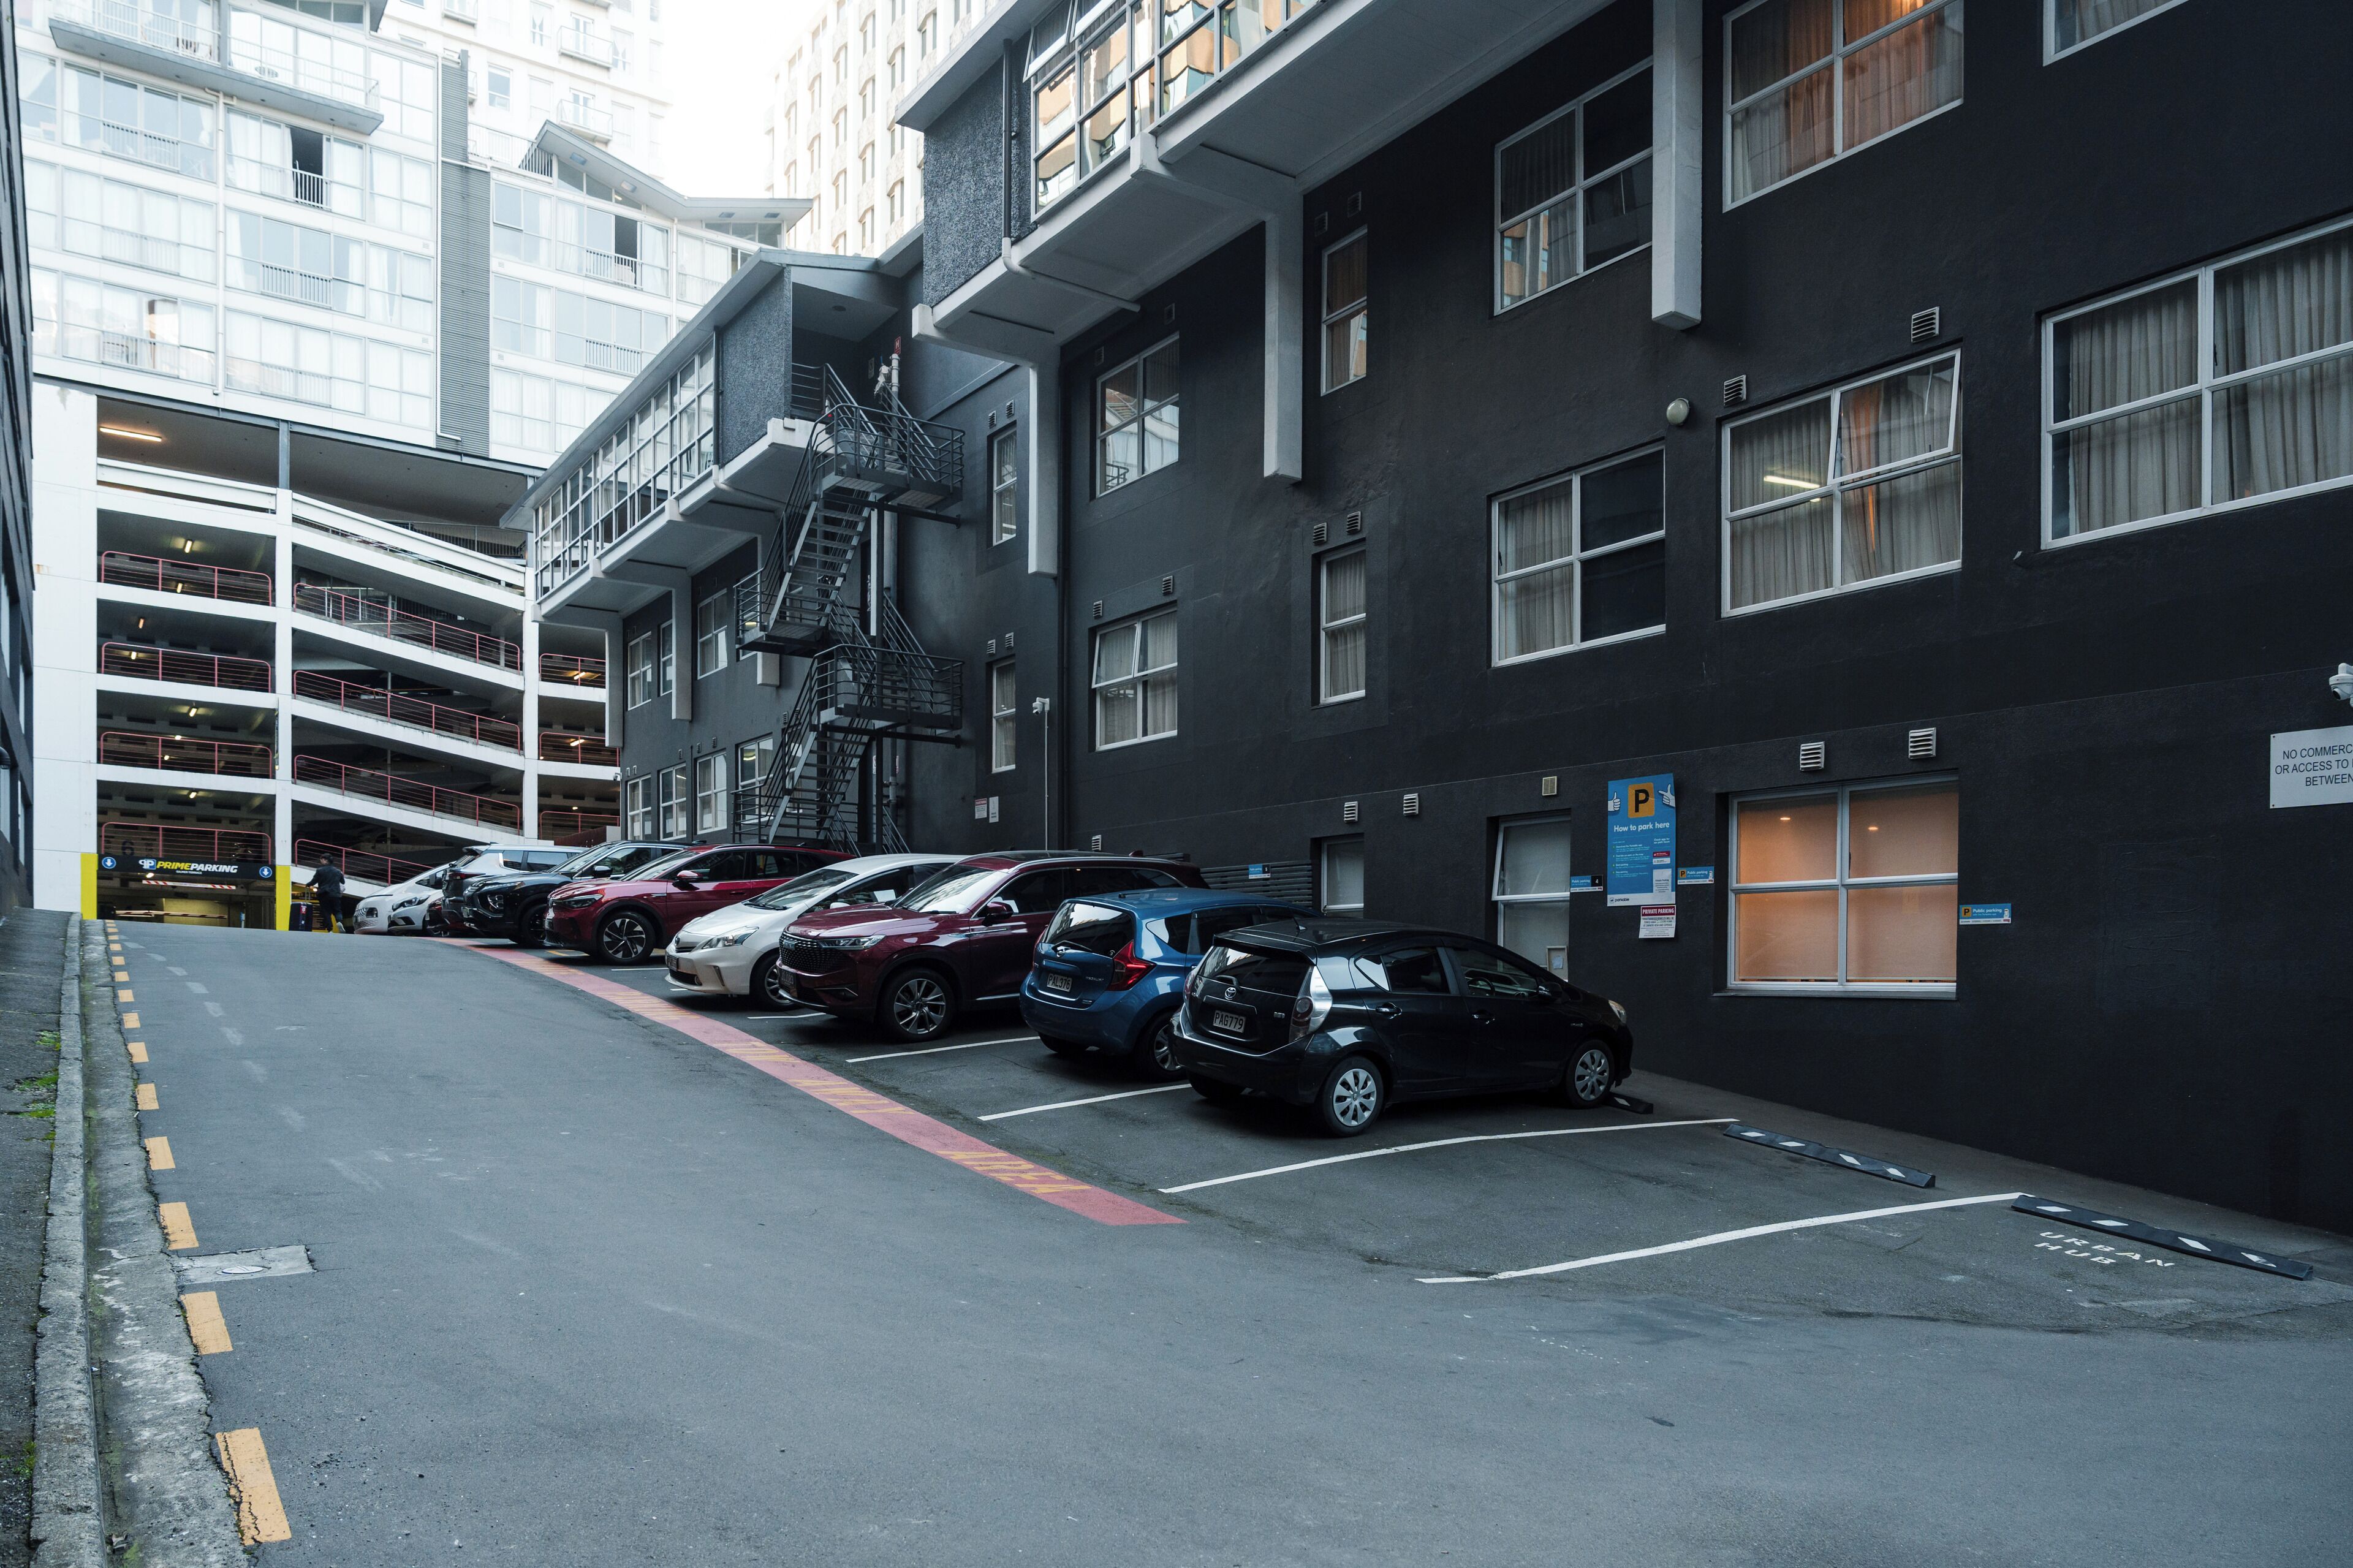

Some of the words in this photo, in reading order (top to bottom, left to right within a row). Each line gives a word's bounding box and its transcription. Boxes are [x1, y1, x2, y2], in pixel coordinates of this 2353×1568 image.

[2283, 749, 2297, 760] NO
[2275, 764, 2289, 775] OR
[2291, 760, 2332, 773] ACCESS
[2335, 759, 2349, 769] TO
[2305, 773, 2353, 786] BETWEEN
[1634, 789, 1650, 812] P
[1638, 822, 1653, 831] park
[1048, 974, 1070, 990] PAL376
[1214, 1012, 1244, 1029] PAG779
[2034, 1242, 2117, 1265] HUB
[2039, 1231, 2175, 1267] URBAN
